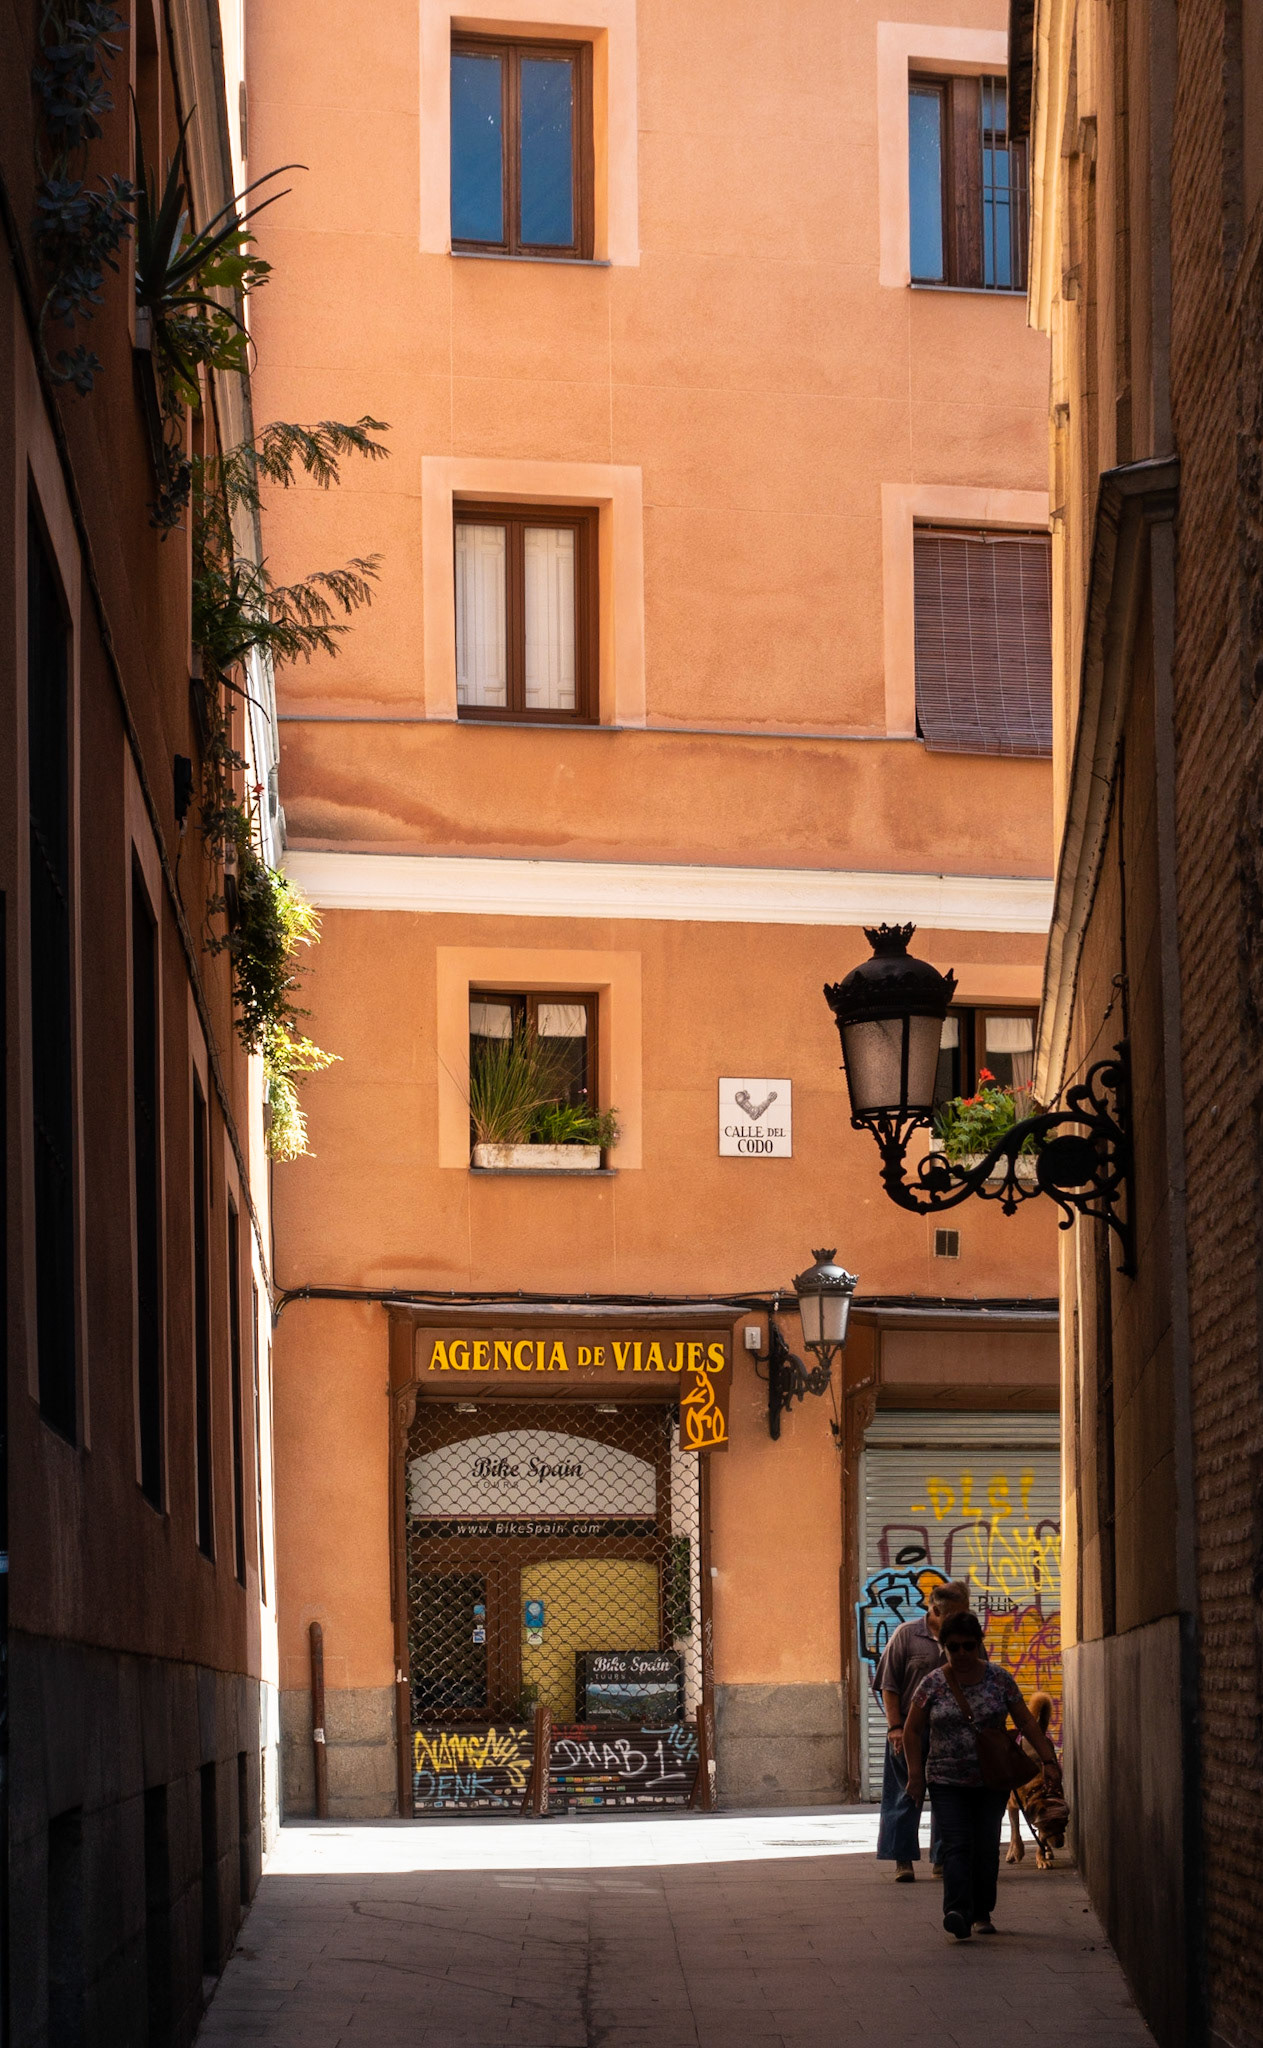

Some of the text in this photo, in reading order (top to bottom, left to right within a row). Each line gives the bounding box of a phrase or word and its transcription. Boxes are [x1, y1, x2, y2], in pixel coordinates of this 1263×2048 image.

[724, 1126, 786, 1138] CALLE DEL
[738, 1139, 773, 1153] CODO
[428, 1340, 726, 1374] AGENCIA DE VIAJES
[472, 1456, 583, 1483] Bike Spain
[474, 1480, 519, 1488] TOURS
[592, 1656, 671, 1675] Bike Spain
